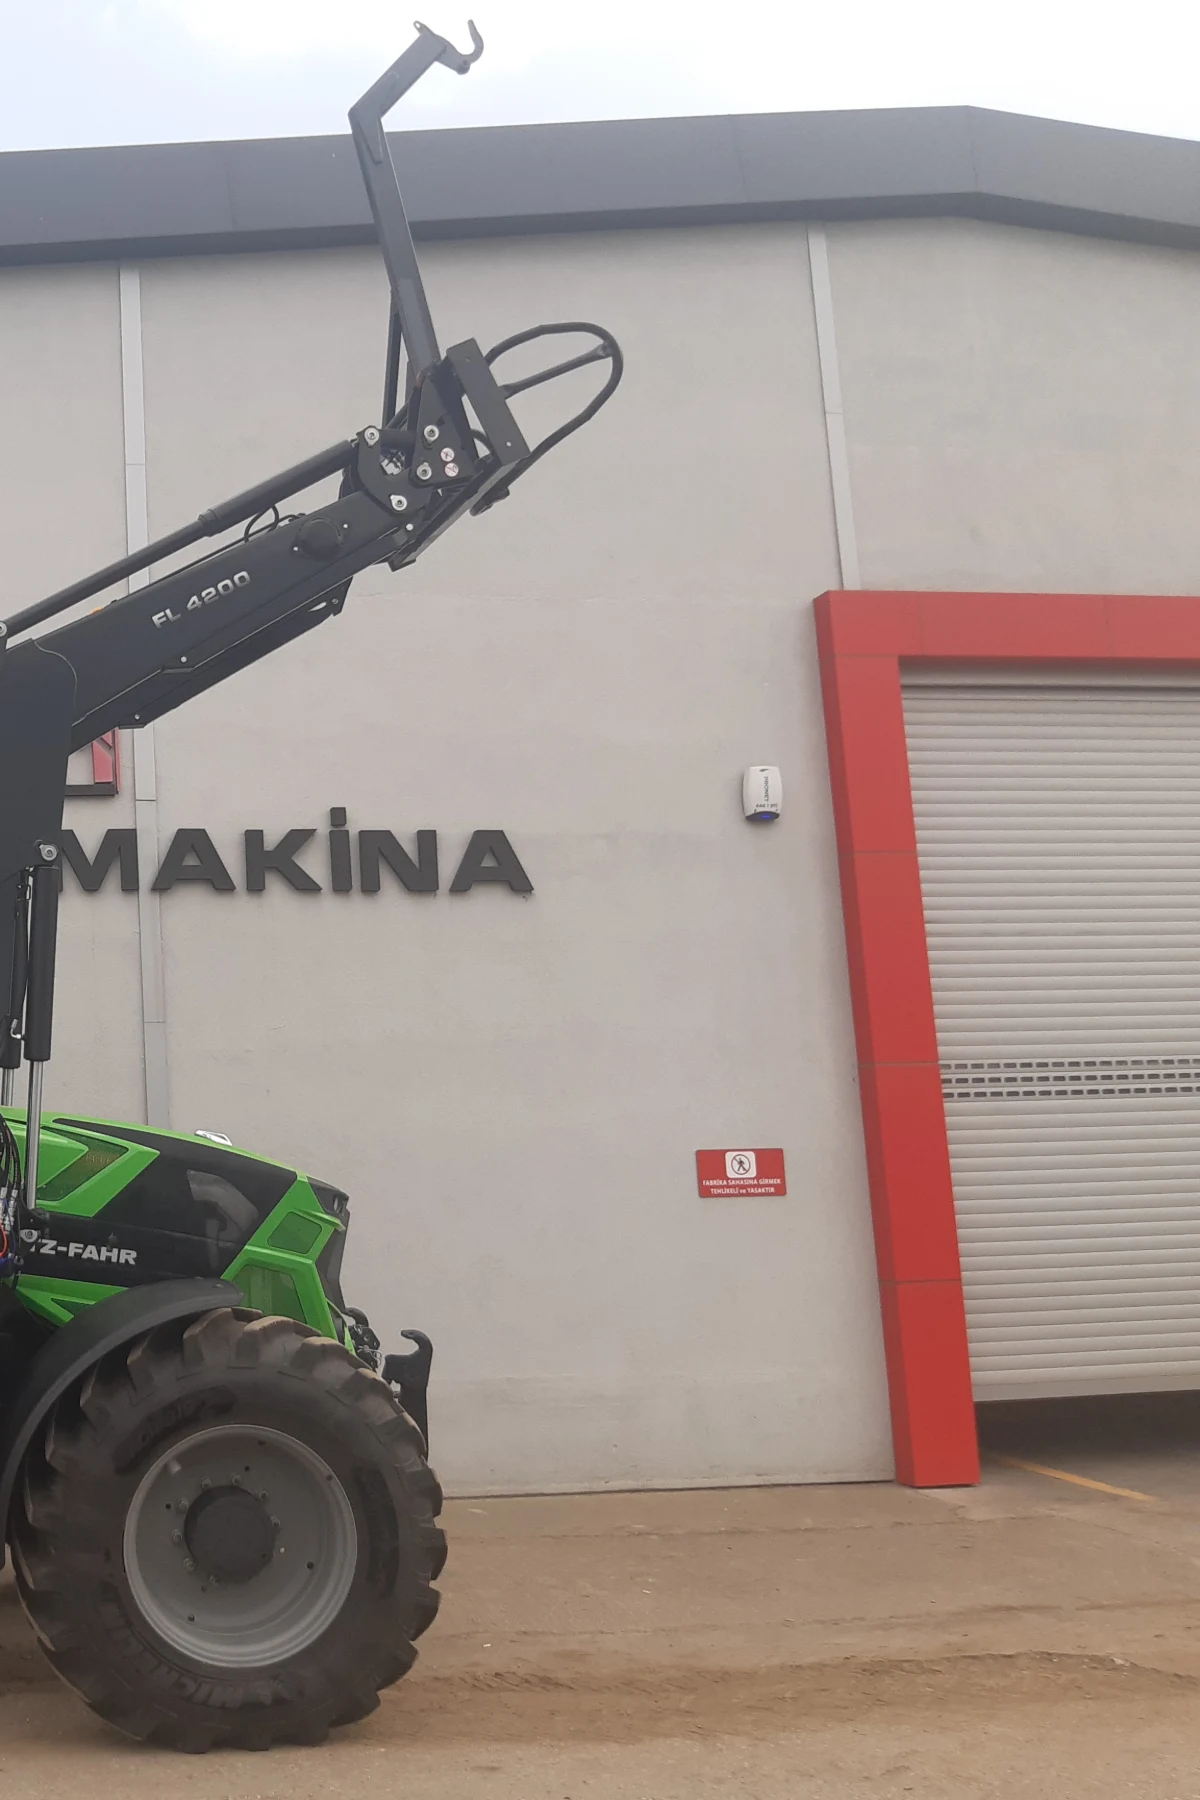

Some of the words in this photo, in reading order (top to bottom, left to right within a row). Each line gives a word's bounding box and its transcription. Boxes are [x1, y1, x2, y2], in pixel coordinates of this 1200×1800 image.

[151, 608, 181, 629] FL
[186, 570, 251, 611] 4200
[60, 807, 534, 892] MAKİNA
[702, 1178, 727, 1186] FABRİKA
